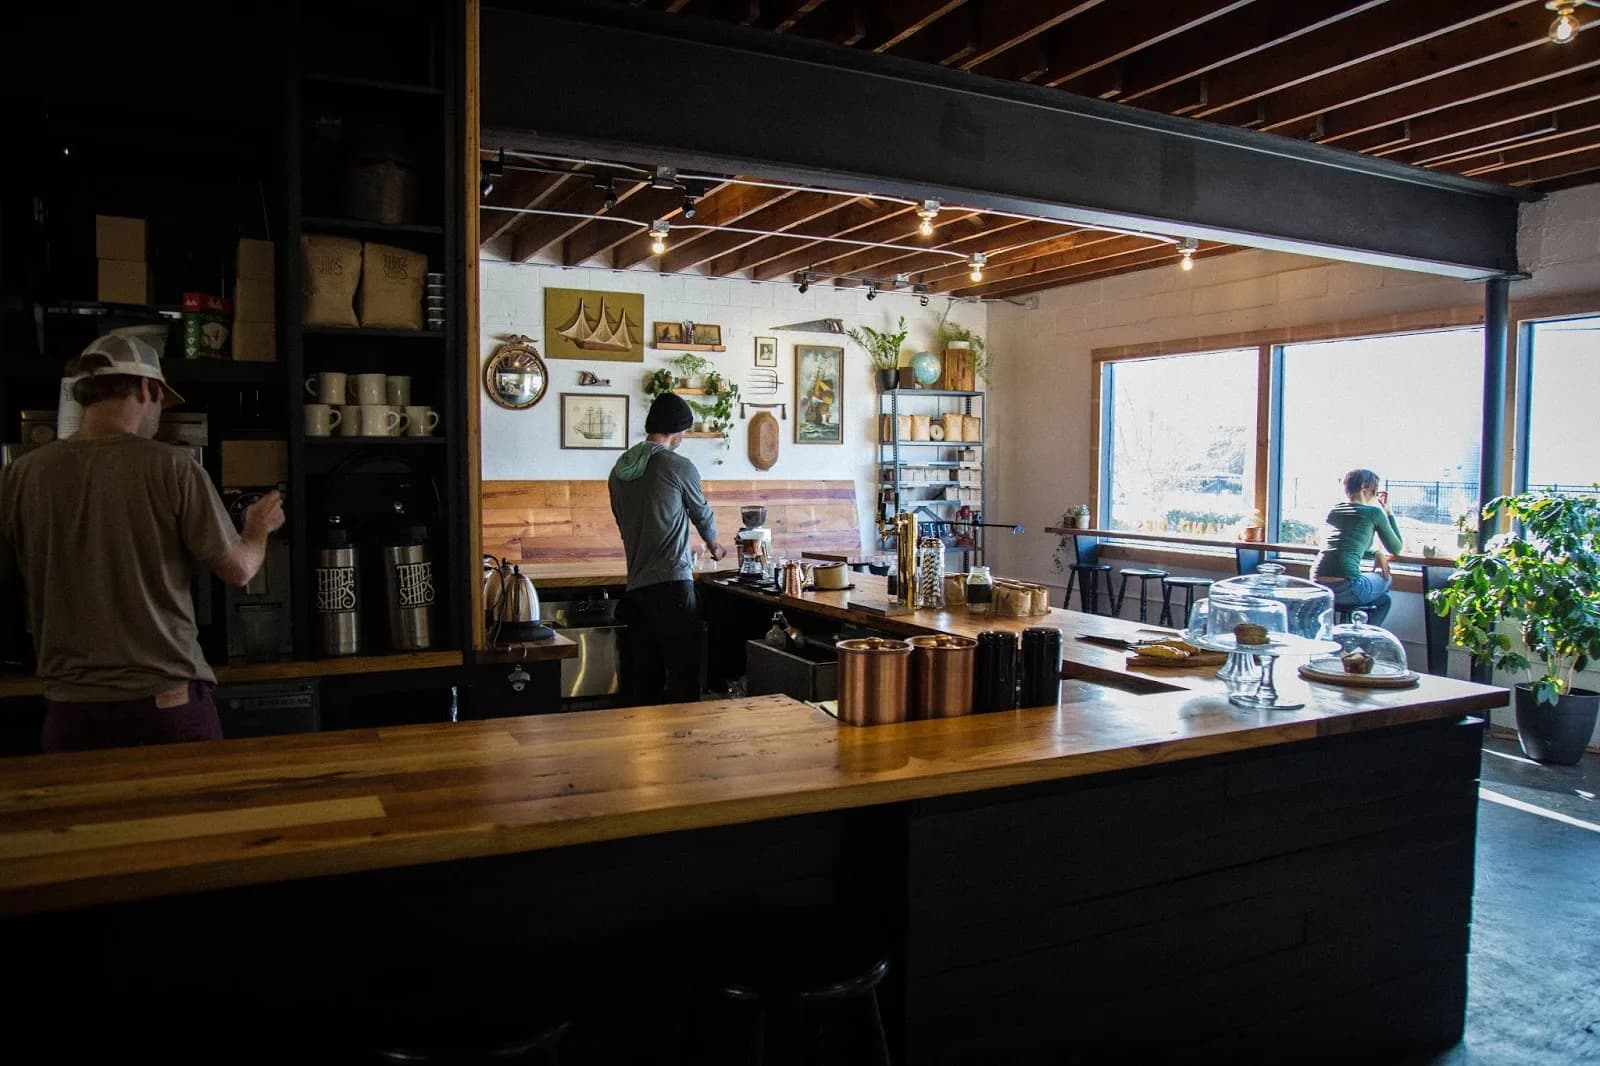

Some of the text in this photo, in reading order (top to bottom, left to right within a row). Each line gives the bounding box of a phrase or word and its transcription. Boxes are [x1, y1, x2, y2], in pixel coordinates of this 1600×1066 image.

[315, 567, 355, 592] THREE
[396, 561, 433, 588] THREE
[316, 582, 356, 609] SHIPS
[399, 576, 436, 605] SHIPS
